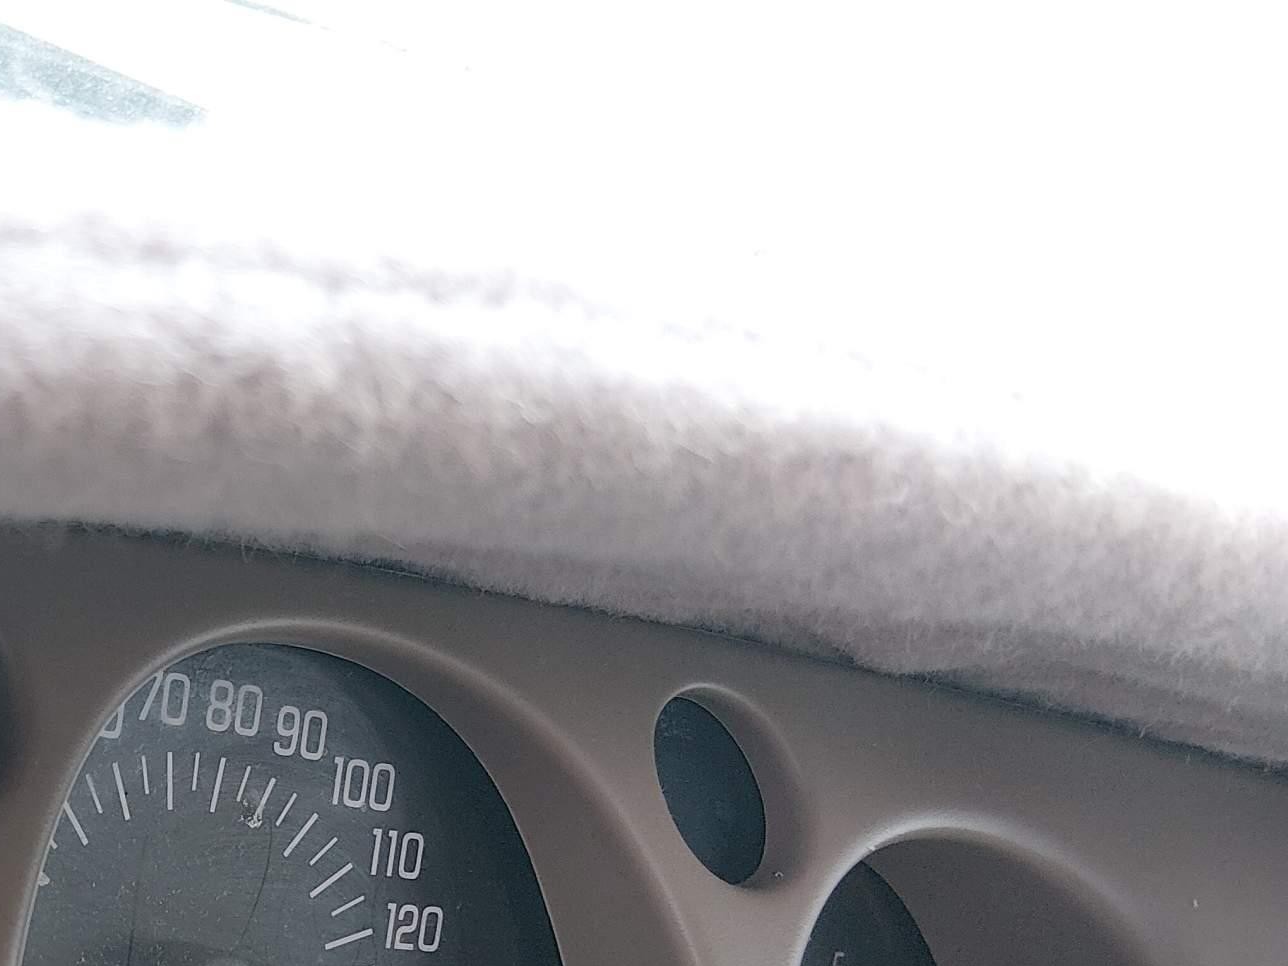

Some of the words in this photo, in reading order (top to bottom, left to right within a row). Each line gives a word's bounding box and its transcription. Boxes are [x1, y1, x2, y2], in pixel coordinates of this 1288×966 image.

[206, 680, 262, 736] 80
[274, 706, 328, 760] 90
[332, 756, 395, 811] 100
[370, 828, 424, 880] 110
[385, 903, 443, 952] 120
